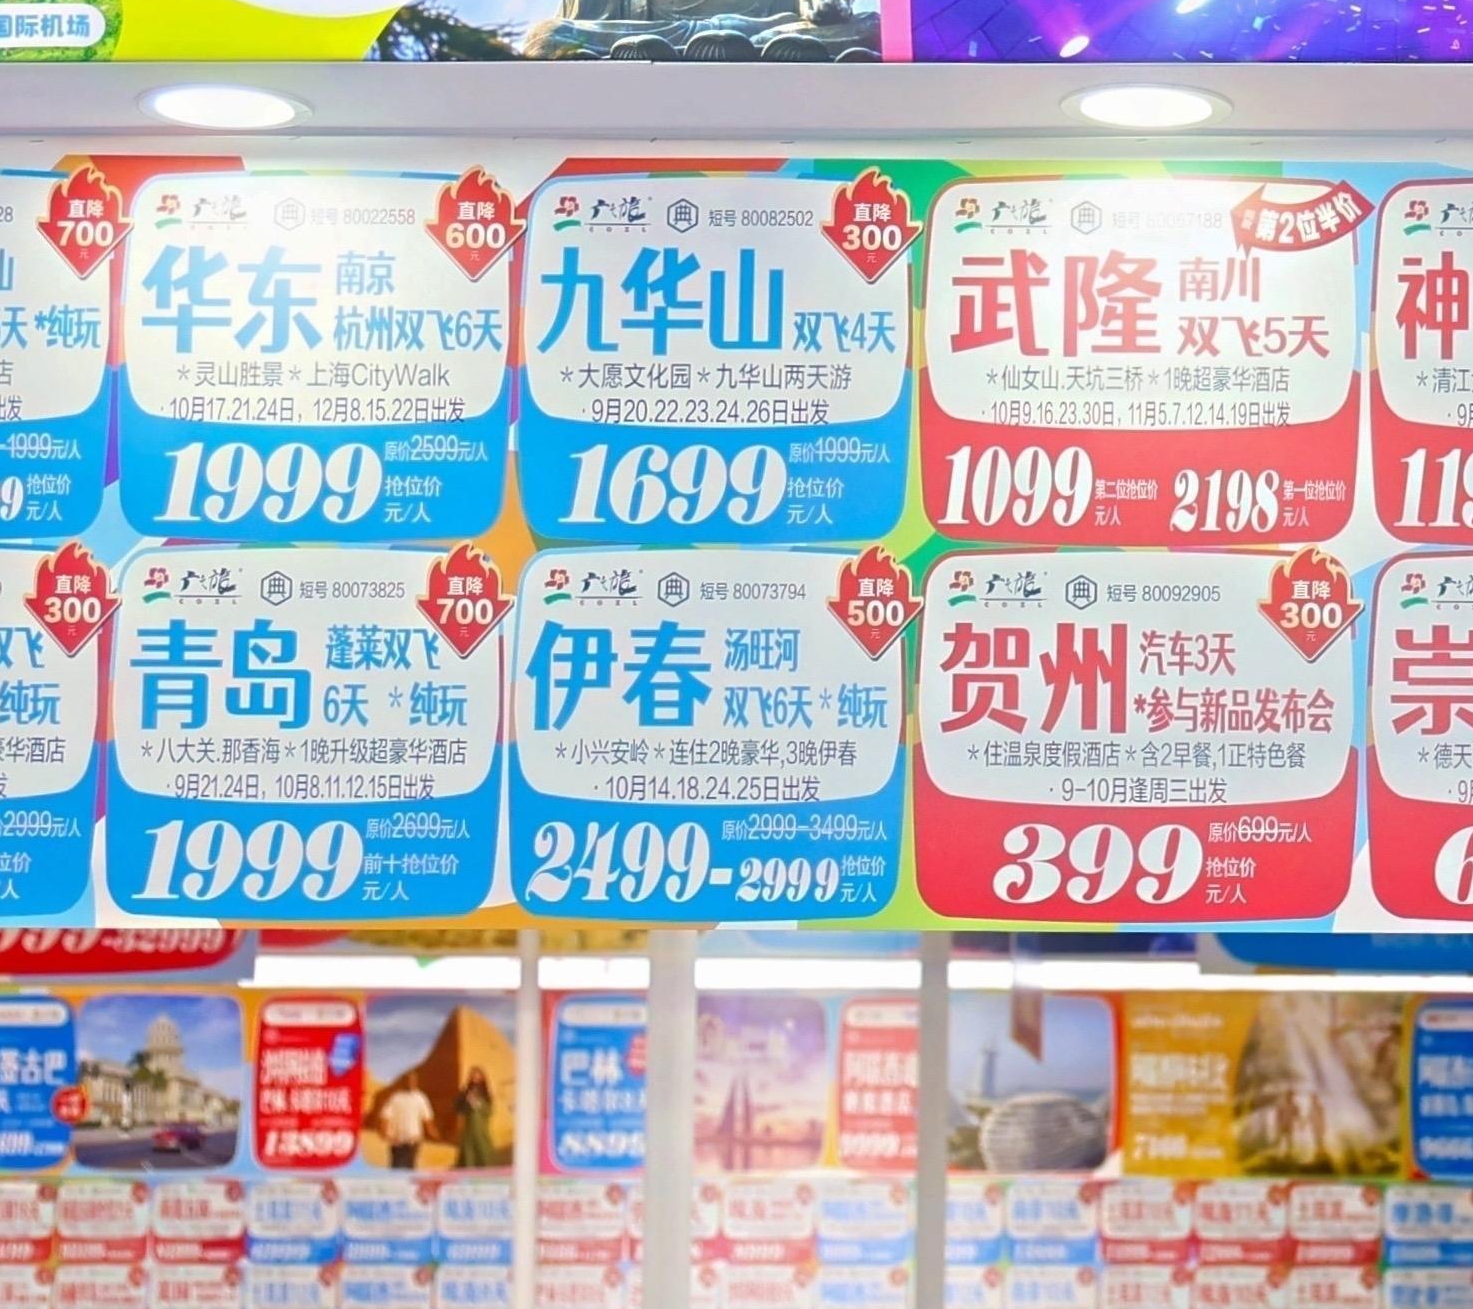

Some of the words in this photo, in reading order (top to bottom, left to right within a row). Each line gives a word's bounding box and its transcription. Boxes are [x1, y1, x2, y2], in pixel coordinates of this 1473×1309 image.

[1254, 192, 1361, 244] 第2位半价
[141, 245, 323, 353] 华东
[537, 247, 784, 356] 九华山
[793, 311, 895, 353] 双飞4天
[950, 248, 1162, 357] 武隆
[1178, 257, 1260, 302] 南川
[333, 306, 502, 351] 杭州双飞6天
[153, 443, 382, 523] 1999
[559, 443, 787, 525] 1699
[937, 446, 1094, 526] 1099
[1170, 469, 1280, 533] 2198
[130, 619, 311, 729] 青岛
[526, 620, 713, 731] 伊春
[940, 623, 1127, 734] 贺州
[132, 819, 363, 901] 1999
[993, 823, 1203, 905] 399
